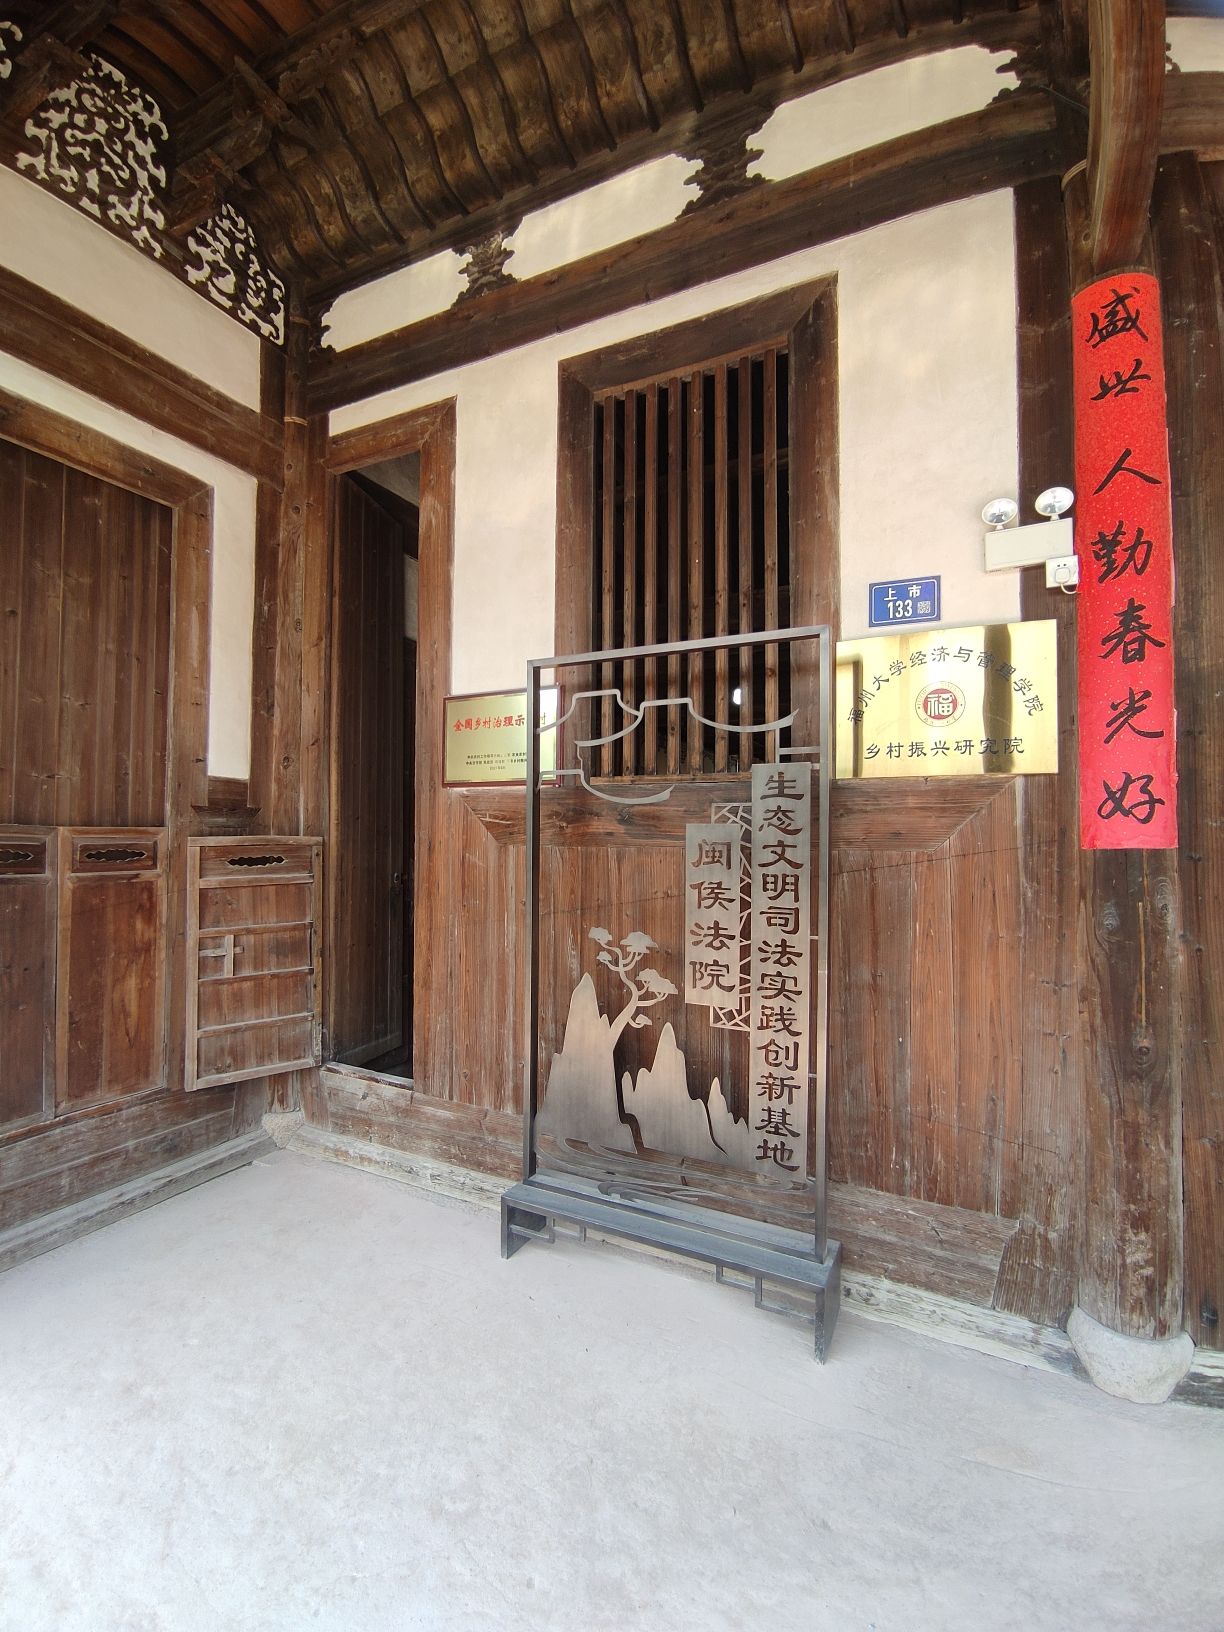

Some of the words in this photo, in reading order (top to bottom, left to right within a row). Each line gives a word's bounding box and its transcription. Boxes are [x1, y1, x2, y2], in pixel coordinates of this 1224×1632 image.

[884, 585, 922, 601] 上市
[887, 600, 913, 619] 133
[848, 646, 1044, 723] 福州大学经济与管理学院
[453, 712, 547, 732] 全国乡村治理示村
[864, 736, 1025, 760] 乡村振兴研究院
[688, 838, 737, 993] 闽侯法院
[754, 771, 805, 1172] 生态文明司法实践创新基地
